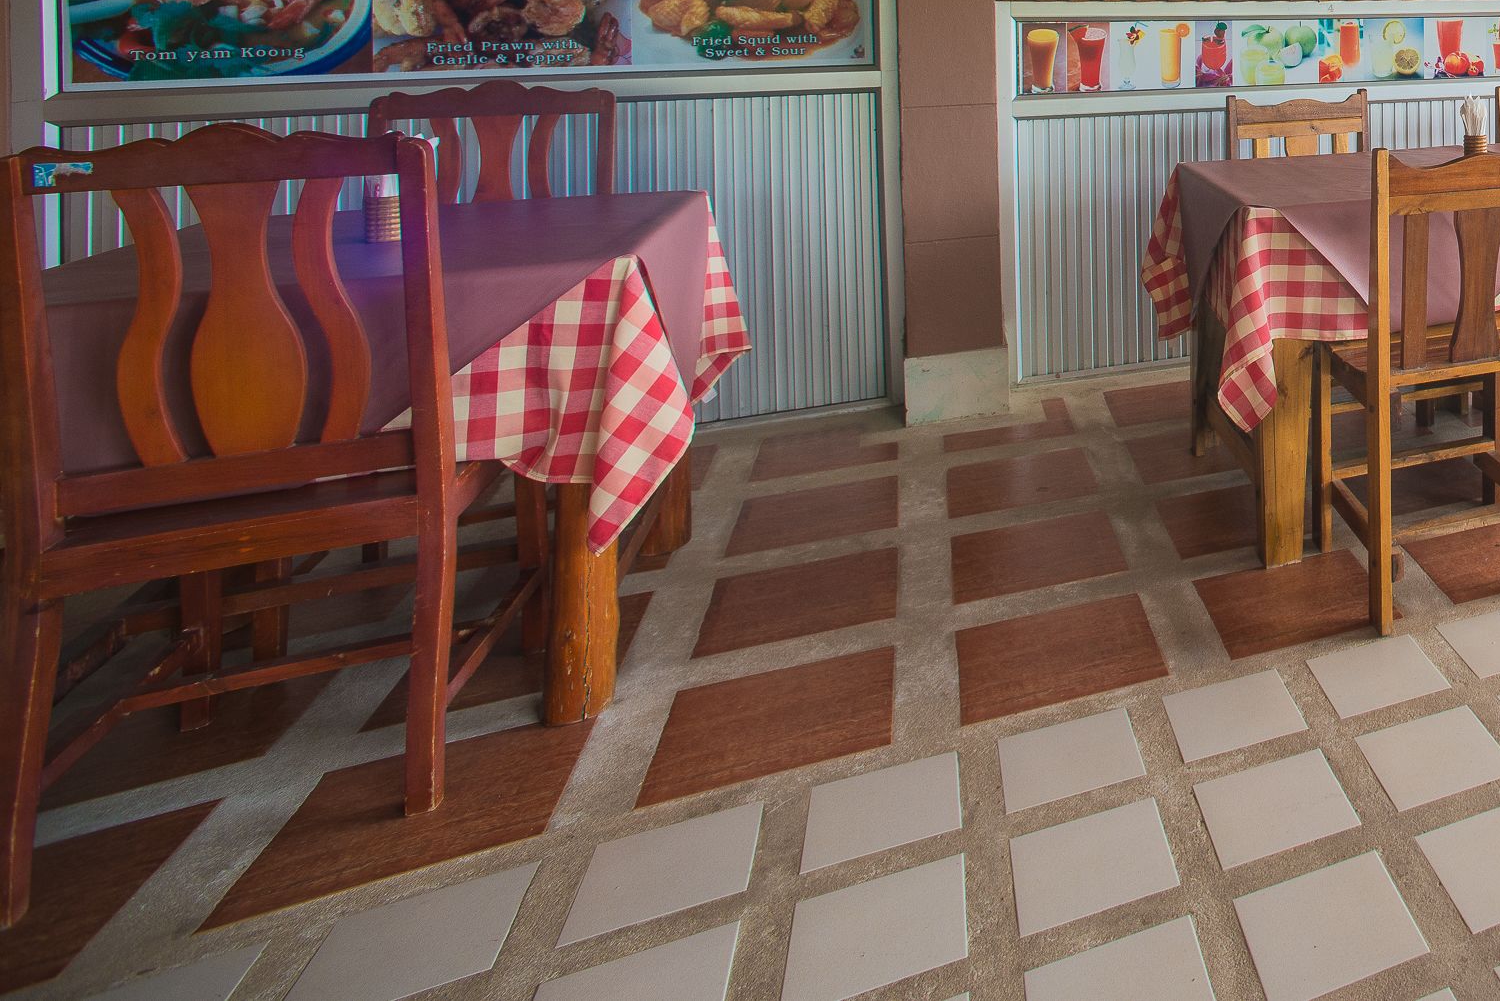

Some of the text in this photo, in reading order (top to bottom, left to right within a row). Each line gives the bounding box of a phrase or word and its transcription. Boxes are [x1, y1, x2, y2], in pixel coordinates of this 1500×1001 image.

[426, 39, 579, 53] Fried Prawn with
[692, 34, 818, 46] Fried Squid with
[129, 47, 306, 63] Tom yam Koong
[705, 46, 807, 57] Sweet & Sour
[432, 52, 574, 65] Garlic & Pepper
